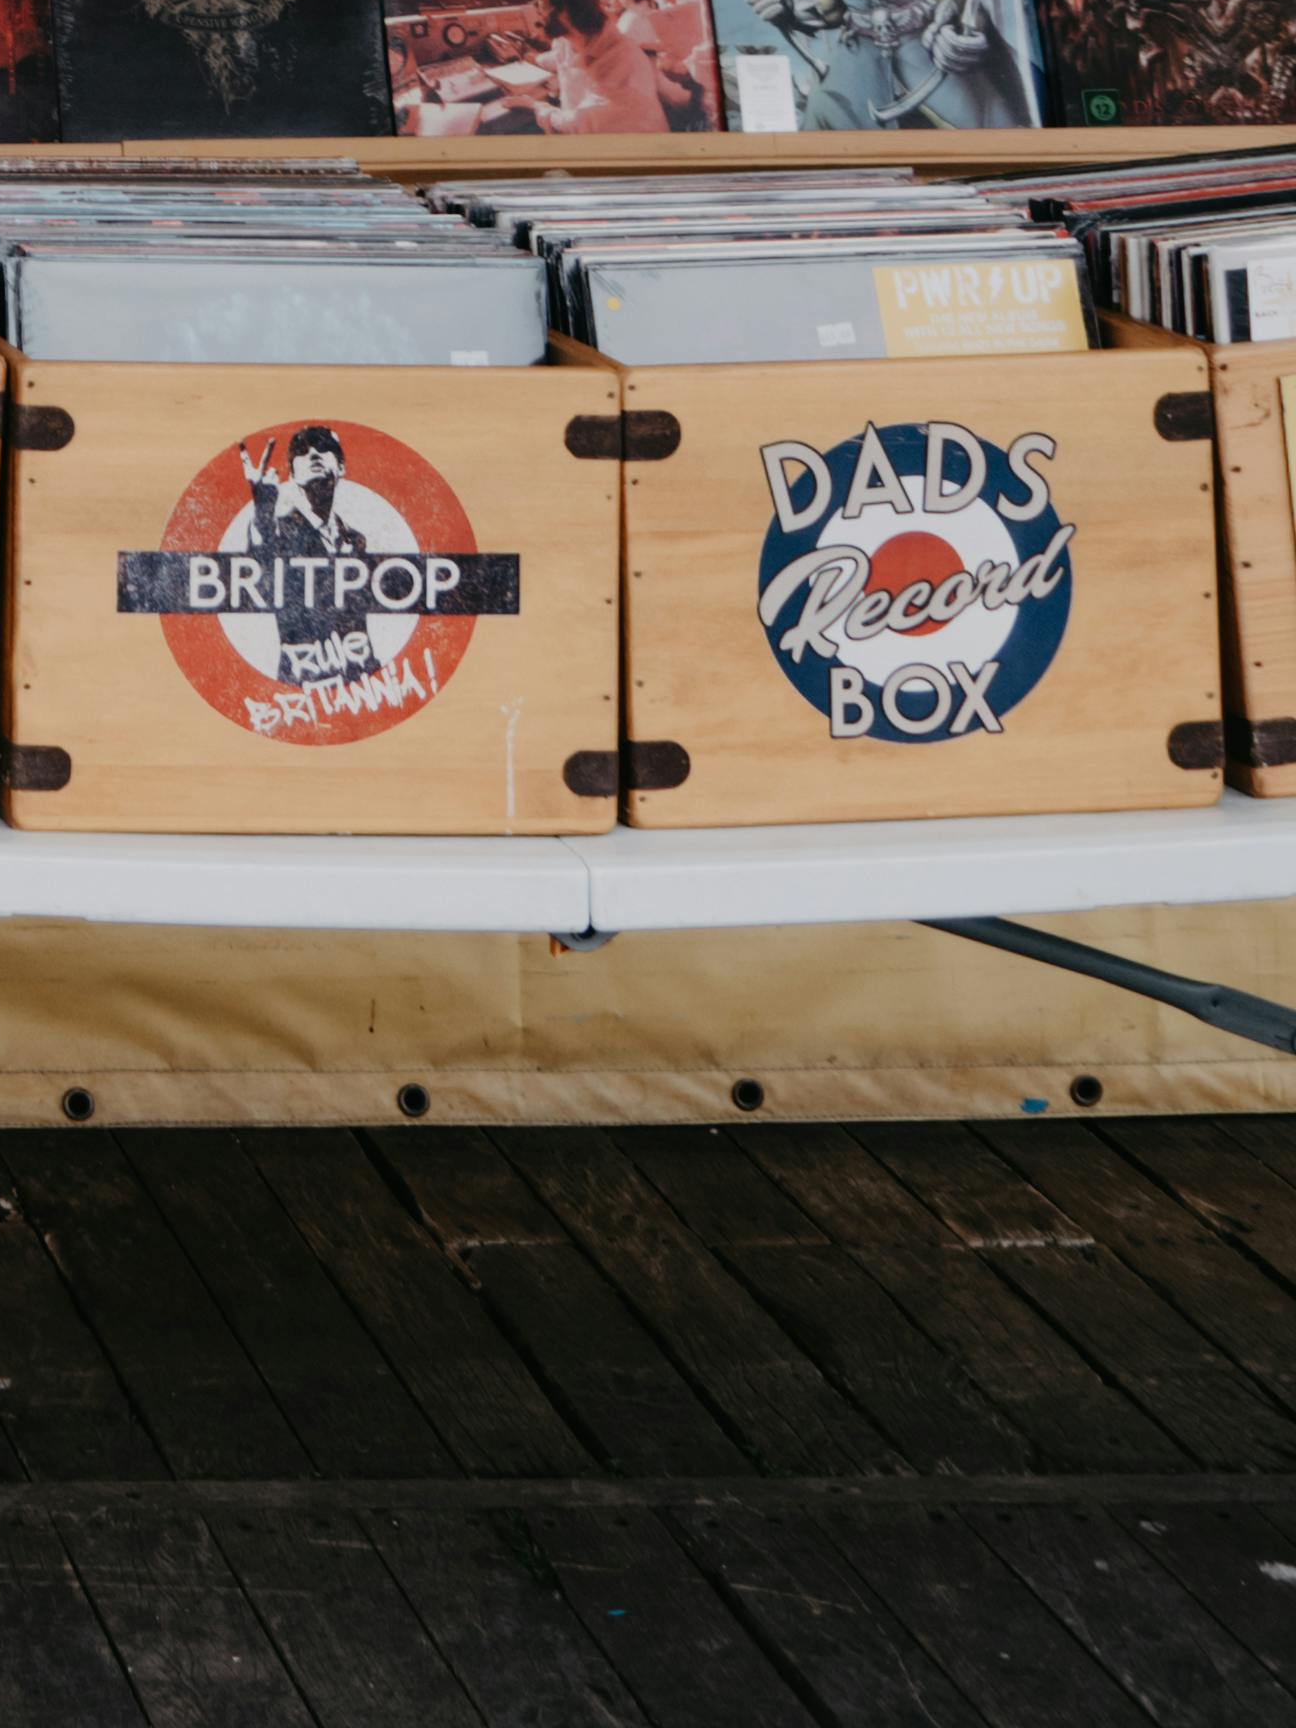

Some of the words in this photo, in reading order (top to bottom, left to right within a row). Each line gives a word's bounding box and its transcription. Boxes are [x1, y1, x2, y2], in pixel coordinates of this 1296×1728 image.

[760, 420, 1058, 534] DADS
[189, 556, 462, 610] BRITPOP
[757, 523, 1078, 664] Record
[830, 660, 1005, 739] BOX
